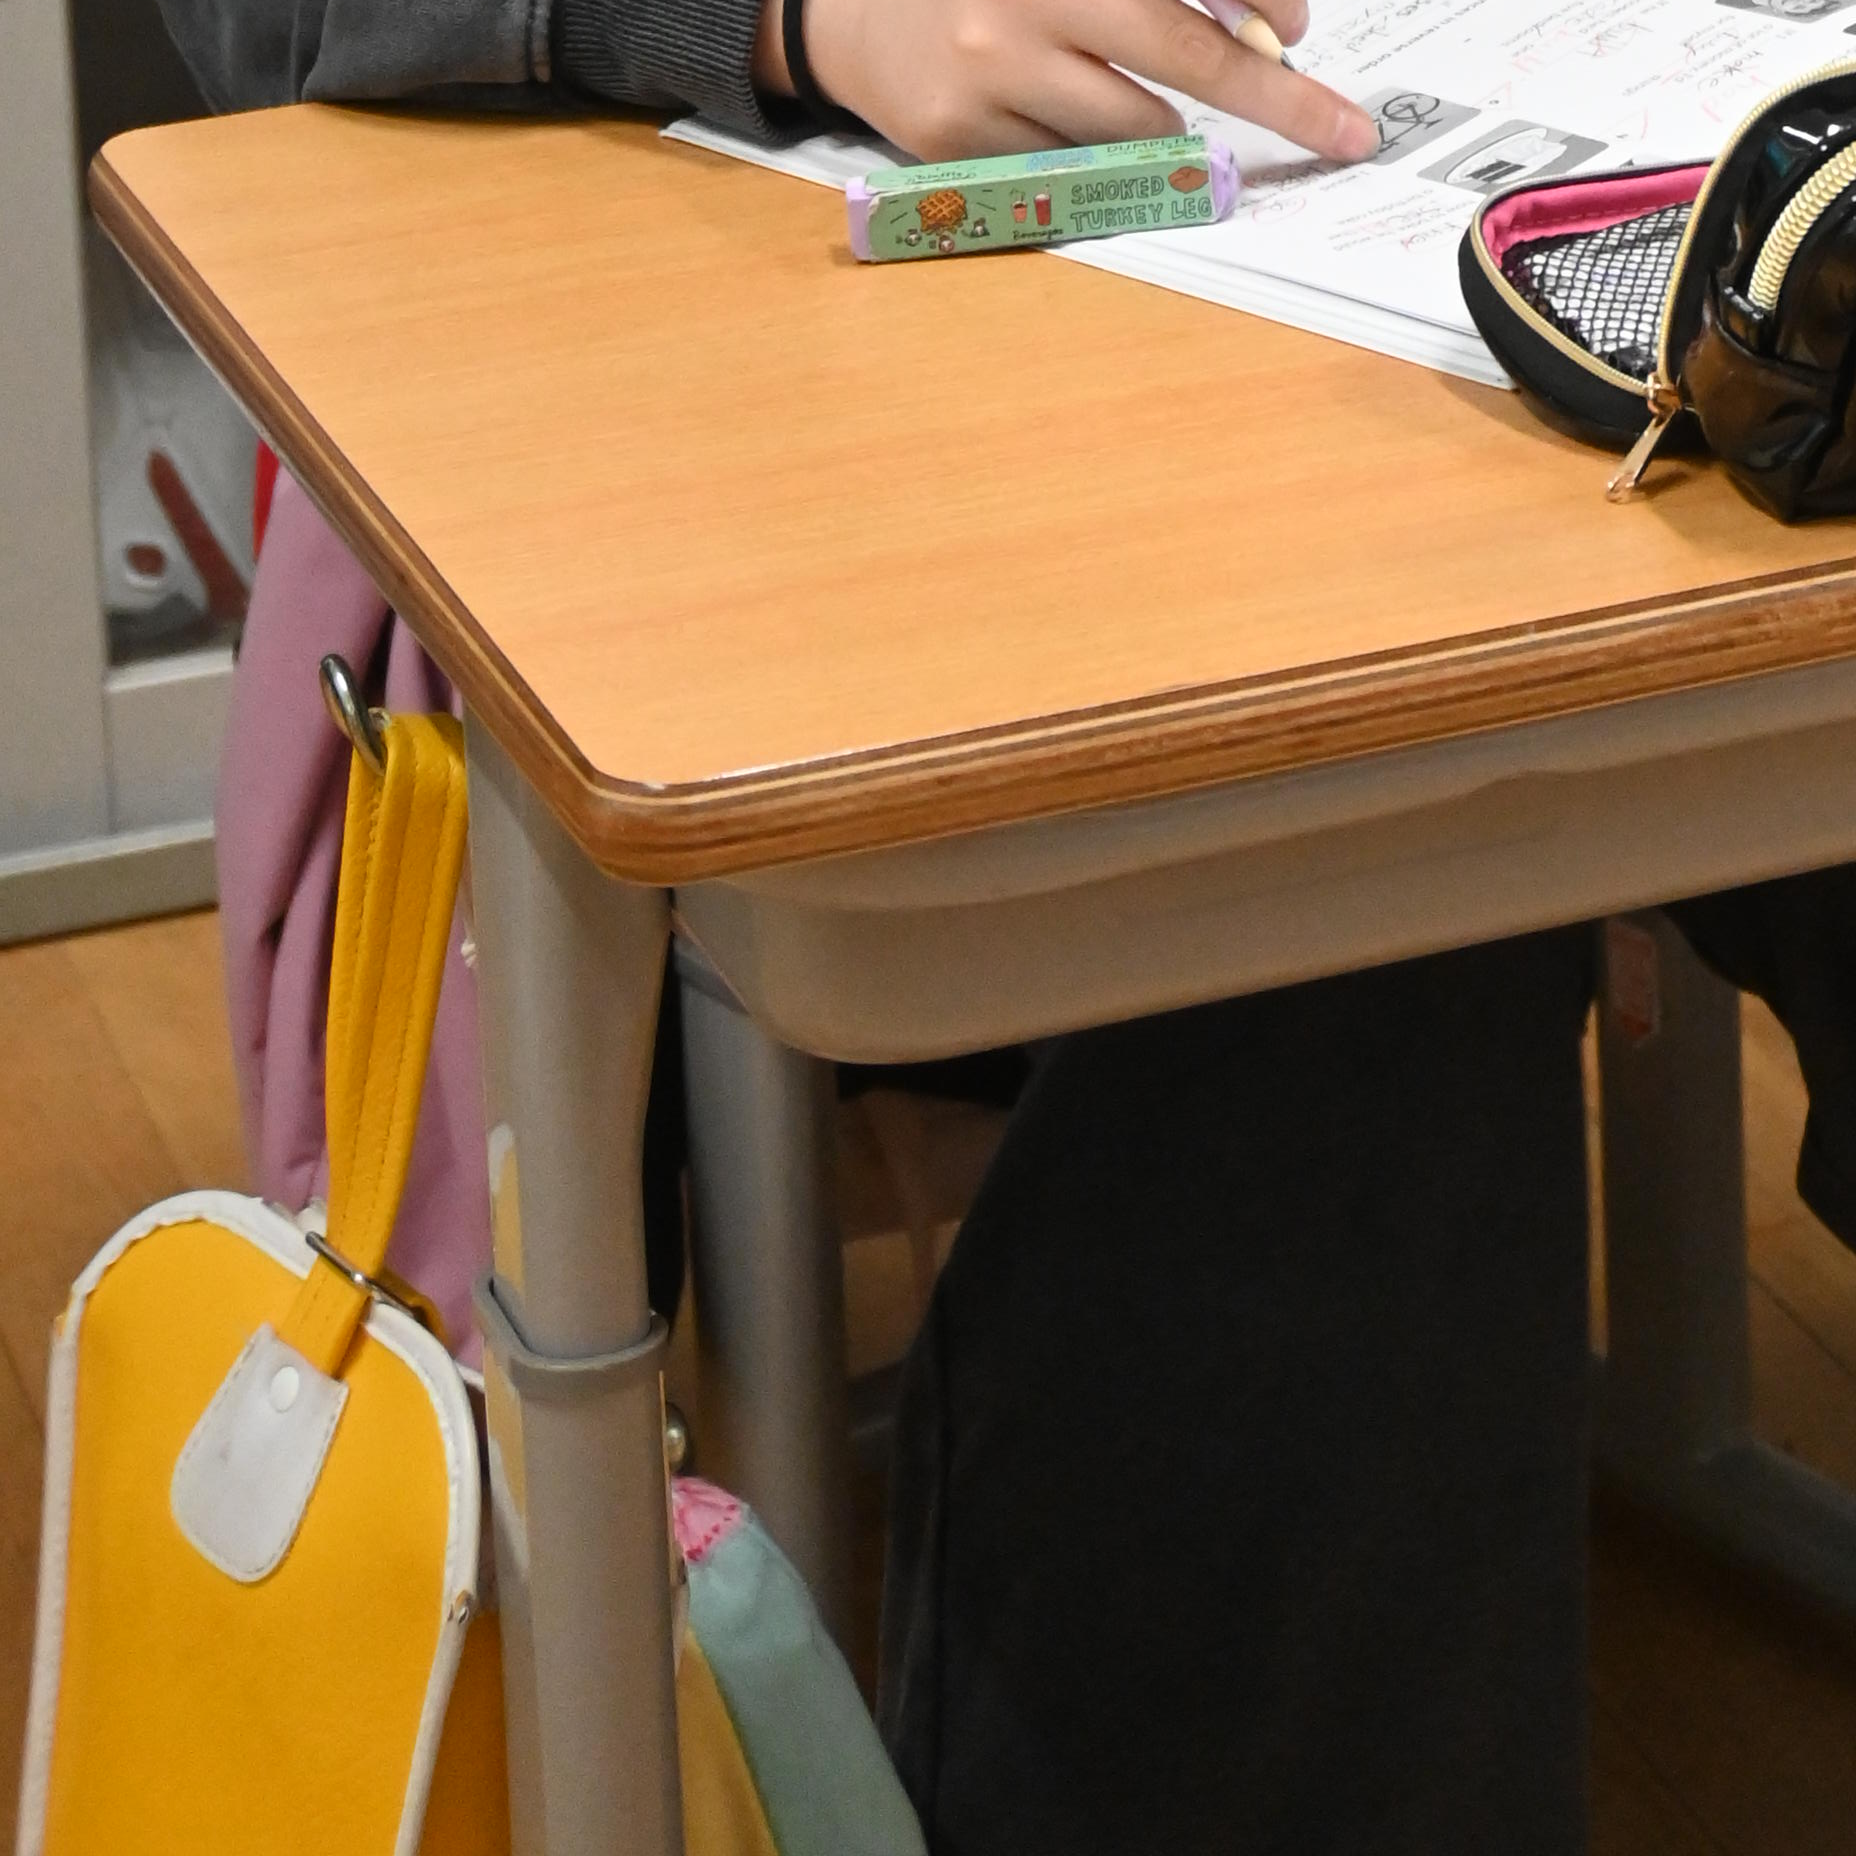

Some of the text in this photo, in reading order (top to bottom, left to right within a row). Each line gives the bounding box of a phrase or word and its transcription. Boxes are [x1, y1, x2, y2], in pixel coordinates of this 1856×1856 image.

[1071, 175, 1164, 205] SMOKED
[1070, 197, 1212, 232] TURKEY LEG
